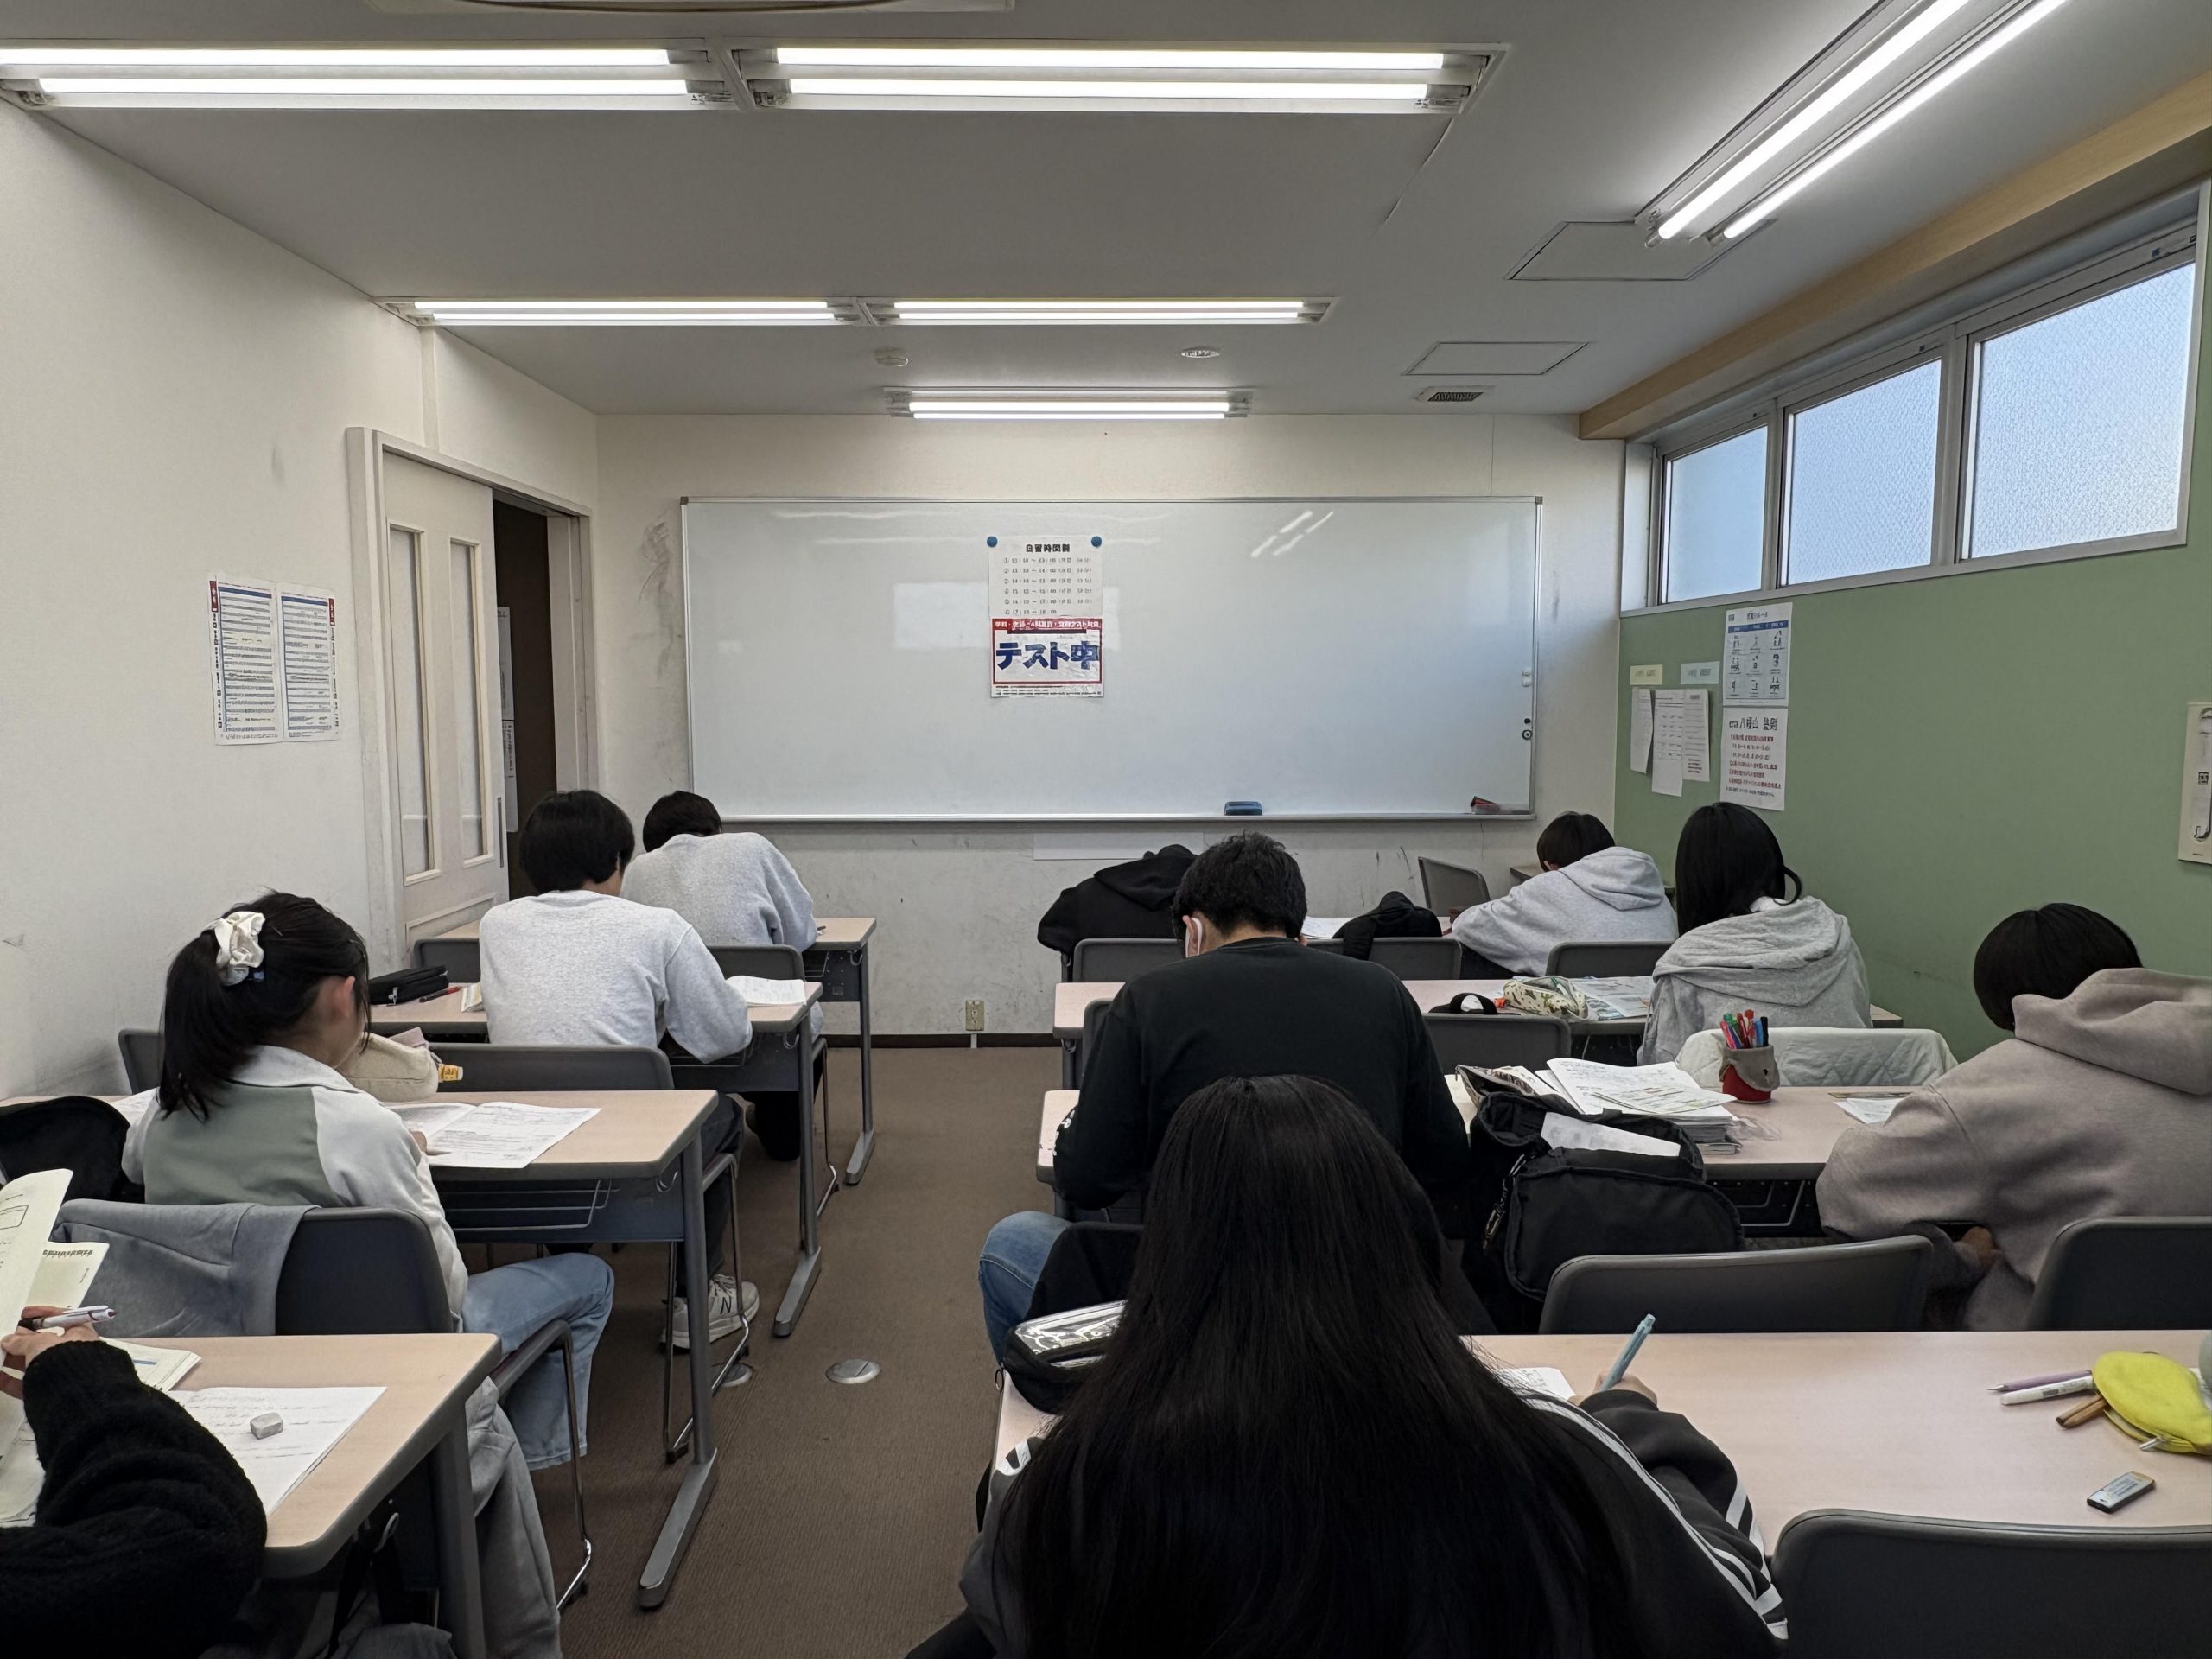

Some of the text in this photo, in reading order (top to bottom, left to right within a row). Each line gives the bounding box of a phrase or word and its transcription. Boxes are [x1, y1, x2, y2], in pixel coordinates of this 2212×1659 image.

[995, 640, 1099, 671] テスト中
[720, 1296, 732, 1314] N
